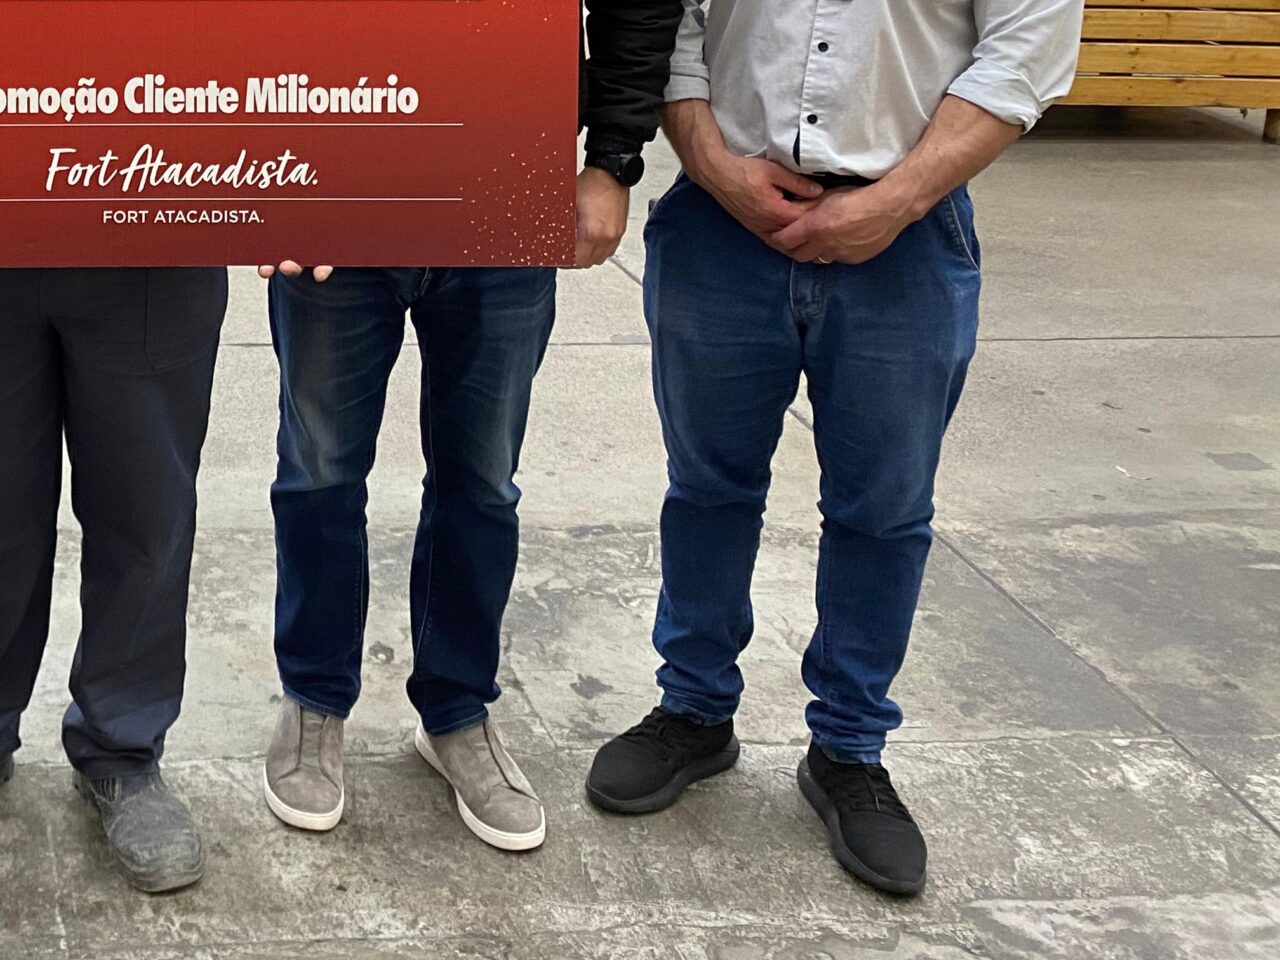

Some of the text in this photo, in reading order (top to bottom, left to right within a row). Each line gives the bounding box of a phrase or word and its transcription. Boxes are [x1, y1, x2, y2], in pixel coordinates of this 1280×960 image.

[124, 74, 239, 114] Cliente
[245, 74, 419, 114] Milionário
[45, 143, 319, 193] Fort Atacadista.
[103, 210, 265, 224] FORT ATACADISTA.
